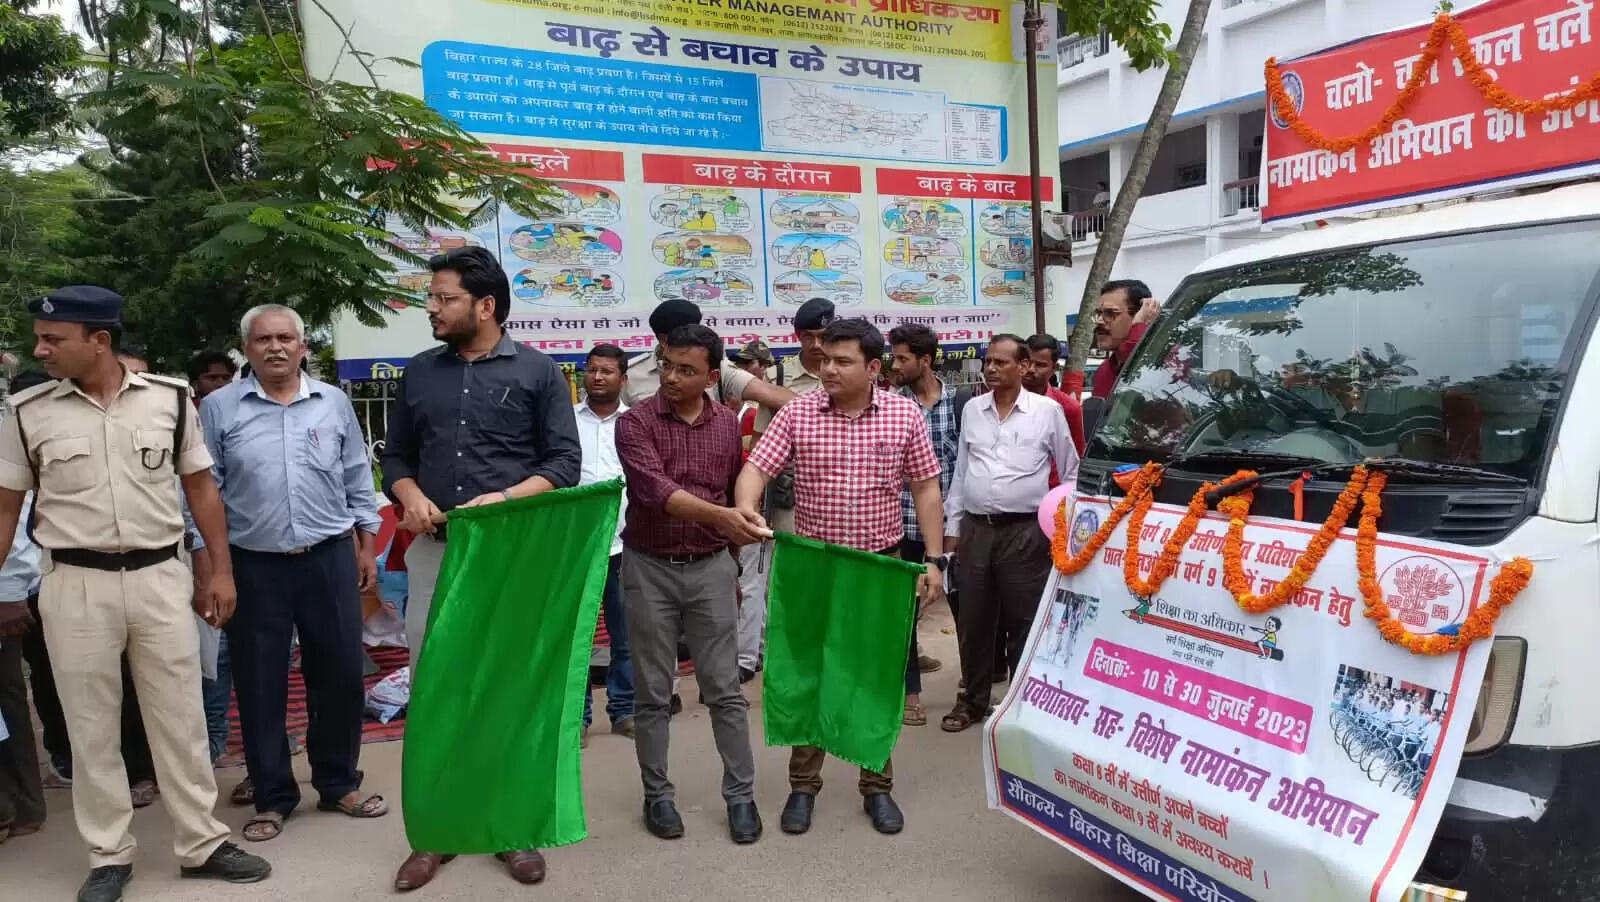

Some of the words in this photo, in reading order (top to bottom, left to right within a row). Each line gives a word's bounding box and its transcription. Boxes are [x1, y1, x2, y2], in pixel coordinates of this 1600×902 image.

[728, 0, 857, 25] MANAGEMANT
[861, 14, 954, 36] AUTHORITY
[444, 48, 476, 64] बिहार
[480, 54, 508, 66] राज्य
[511, 57, 523, 69] के
[528, 61, 543, 70] 28
[545, 60, 570, 73] जिले
[574, 66, 594, 77] बाढ़
[596, 68, 624, 79] प्रवण
[702, 76, 724, 88] जिले
[545, 21, 622, 58] बाढ़
[630, 26, 671, 57] से
[680, 37, 779, 69] बचाव
[788, 45, 830, 73] के
[837, 55, 923, 83] उपाय
[446, 71, 469, 84] बाढ़
[472, 73, 501, 85] प्रवण
[523, 79, 545, 91] बाढ़
[580, 84, 601, 96] बाढ़
[616, 86, 645, 98] दौरान
[447, 88, 460, 100] के
[521, 98, 569, 109] अपनाकर
[574, 101, 593, 113] बाढ़
[717, 111, 742, 123] किया
[448, 109, 464, 119] जा
[469, 113, 503, 123] सकता
[523, 115, 545, 128] बाढ़
[609, 122, 635, 133] उपाय
[692, 163, 739, 185] बाढ़
[743, 161, 767, 182] के
[772, 162, 832, 185] दौरान
[916, 176, 954, 196] बाढ़
[958, 173, 978, 193] के
[983, 180, 1017, 196] बाद
[550, 317, 587, 329] ऐसा
[592, 317, 611, 329] हो
[616, 317, 641, 329] जो
[703, 316, 718, 327] से
[725, 317, 771, 328] बचाए,
[874, 314, 890, 325] कि
[941, 315, 960, 324] बन
[1141, 521, 1163, 543] वर्ग
[1184, 560, 1206, 585] वर्ग
[1206, 567, 1217, 587] 9
[1327, 586, 1356, 628] हेतु
[1155, 598, 1181, 619] शिक्षा
[1183, 608, 1198, 623] का
[1200, 612, 1246, 636] अधिकार
[1142, 667, 1160, 691] 10
[1163, 669, 1179, 698] से
[1179, 680, 1203, 706] 30
[1206, 688, 1254, 728] जुलाई
[1255, 706, 1307, 745] 2023
[1072, 752, 1095, 777] कक्षा
[1104, 763, 1118, 787] वीं
[1118, 771, 1129, 792] में
[1131, 779, 1162, 809] उत्तीर्ण
[1164, 796, 1195, 825] अपने
[1197, 810, 1229, 840] बच्चों
[1126, 711, 1182, 765] विशेष
[1267, 776, 1380, 847] अभियान
[1007, 778, 1064, 820] सौजन्य-
[1069, 807, 1112, 850] बिहार
[1116, 834, 1161, 877] शिक्षा
[1054, 768, 1067, 787] का
[1068, 776, 1109, 809] नामांकन
[1111, 797, 1135, 824] कक्षा
[1136, 811, 1144, 826] 9
[1147, 810, 1160, 834] वीं
[1161, 819, 1174, 841] में
[1176, 829, 1215, 863] अवश्य
[1216, 849, 1255, 881] करावें
